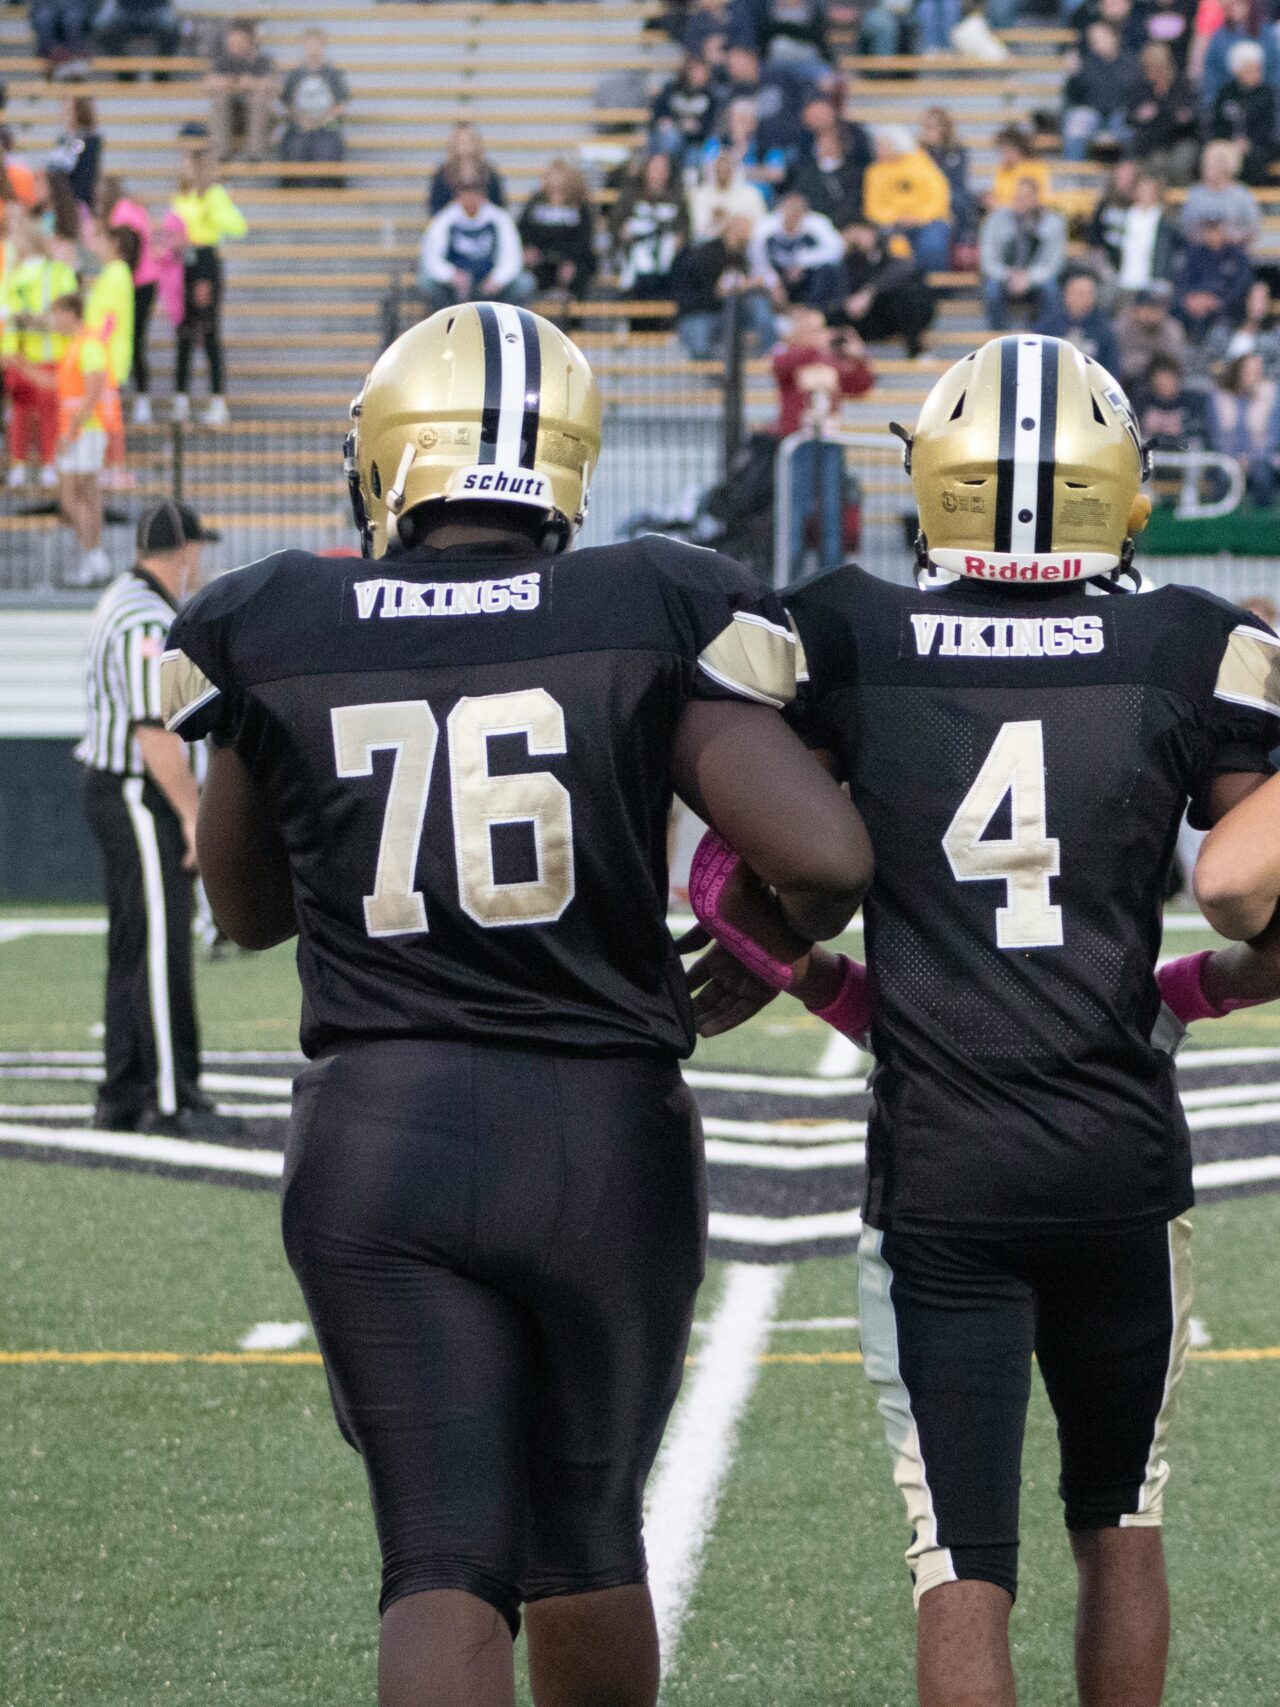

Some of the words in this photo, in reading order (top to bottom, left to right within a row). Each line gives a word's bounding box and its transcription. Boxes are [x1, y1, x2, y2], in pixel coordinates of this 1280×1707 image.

[463, 470, 544, 496] schutt
[964, 556, 1082, 581] Riddell
[353, 572, 541, 619] VIKINGS
[910, 614, 1104, 657] VIKINGS
[330, 688, 575, 937] 76
[942, 720, 1064, 948] 4
